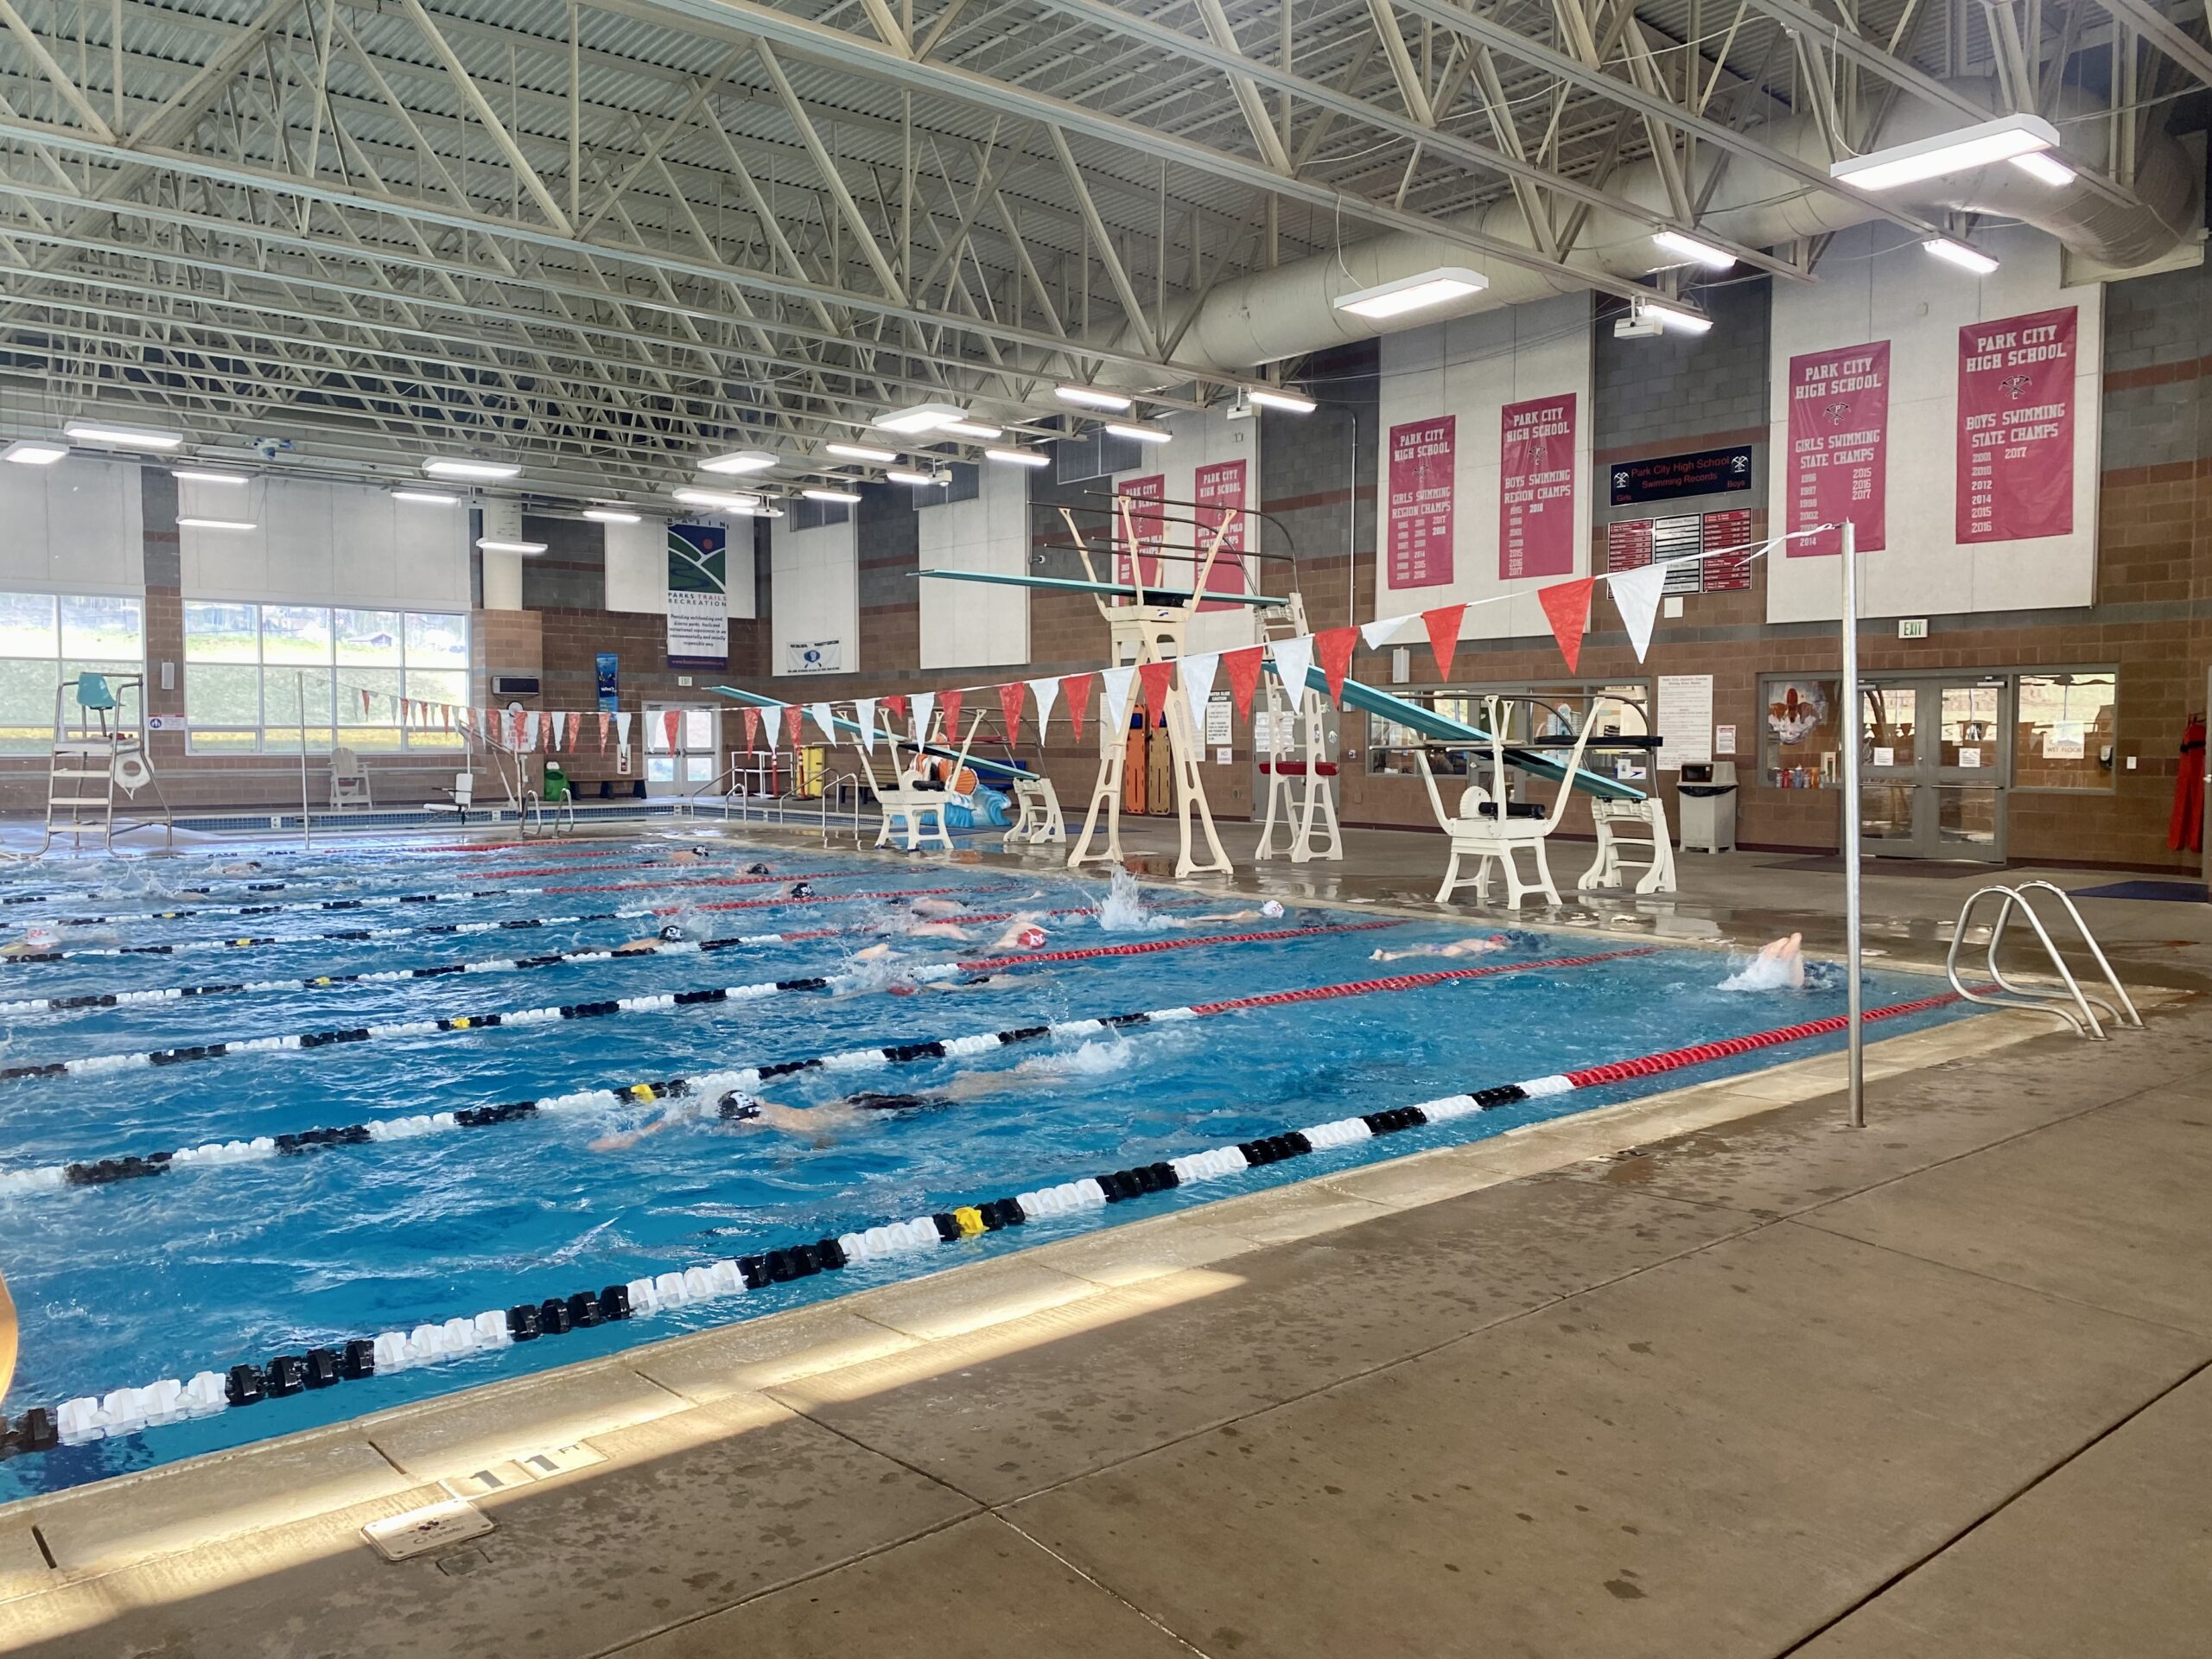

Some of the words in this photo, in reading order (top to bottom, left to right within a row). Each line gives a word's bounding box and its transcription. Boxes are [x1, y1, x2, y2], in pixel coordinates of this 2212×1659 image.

[1977, 332, 2017, 353] PARK
[2023, 324, 2057, 345] CITY
[1966, 353, 2002, 372] HIGH
[2008, 342, 2067, 366] SCHOOL
[1805, 363, 1838, 381] PARK
[1844, 358, 1873, 375] CITY
[1796, 382, 1826, 399] HIGH
[1831, 373, 1881, 394] SCHOOL
[1514, 411, 1538, 427] PARK
[1541, 407, 1563, 422] CITY
[1966, 413, 1996, 430] BOYS
[2002, 403, 2065, 425] SWIMMING
[1400, 432, 1421, 447] PARK
[1425, 428, 1444, 442] CITY
[1507, 428, 1529, 442] HIGH
[1532, 422, 1569, 438] SCHOOL
[1972, 430, 2005, 448] STATE
[2011, 423, 2058, 442] CHAMPS
[1796, 437, 1824, 453] GIRLS
[1828, 429, 1880, 448] SWIMMING
[1395, 448, 1414, 461] HIGH
[1417, 442, 1450, 457] SCHOOL
[1800, 454, 1828, 469] STATE
[1834, 448, 1874, 465] CHAMPS
[2005, 447, 2027, 459] 2017
[1630, 468, 1651, 478] Park
[1654, 465, 1671, 475] City
[1674, 461, 1694, 473] High
[1696, 456, 1729, 468] School
[1853, 467, 1872, 479] 2015
[1203, 472, 1220, 484] PARK
[1223, 469, 1237, 481] CITY
[1505, 475, 1525, 489] BOYS
[1529, 469, 1570, 486] SWIMMING
[1642, 477, 1682, 489] Swimming
[1684, 472, 1718, 483] Records
[1727, 480, 1745, 488] Boys
[1126, 486, 1141, 496] PARK
[1142, 484, 1157, 495] CITY
[1200, 486, 1215, 498] HIGH
[1217, 481, 1241, 495] SCHOOL
[1853, 480, 1872, 490] 2016
[1971, 480, 1992, 490] 2012
[1393, 492, 1413, 505] GIRLS
[1416, 486, 1450, 501] SWIMMING
[1504, 489, 1534, 504] REGION
[1537, 485, 1571, 499] CHAMPS
[1616, 493, 1631, 502] Girls
[1852, 489, 1872, 500] 2017
[1972, 494, 1991, 505] 2014
[1392, 505, 1418, 518] REGION
[1421, 501, 1451, 514] CHAMPS
[1971, 506, 1992, 518] 2015
[1433, 515, 1446, 524] 2017
[1971, 521, 1992, 533] 2016
[1230, 523, 1243, 533] POLO
[1800, 537, 1816, 546] 2014
[1509, 549, 1522, 557] 2015
[1509, 567, 1522, 575] 2017
[1904, 621, 1923, 636] EXIT
[558, 1444, 580, 1455] FT
